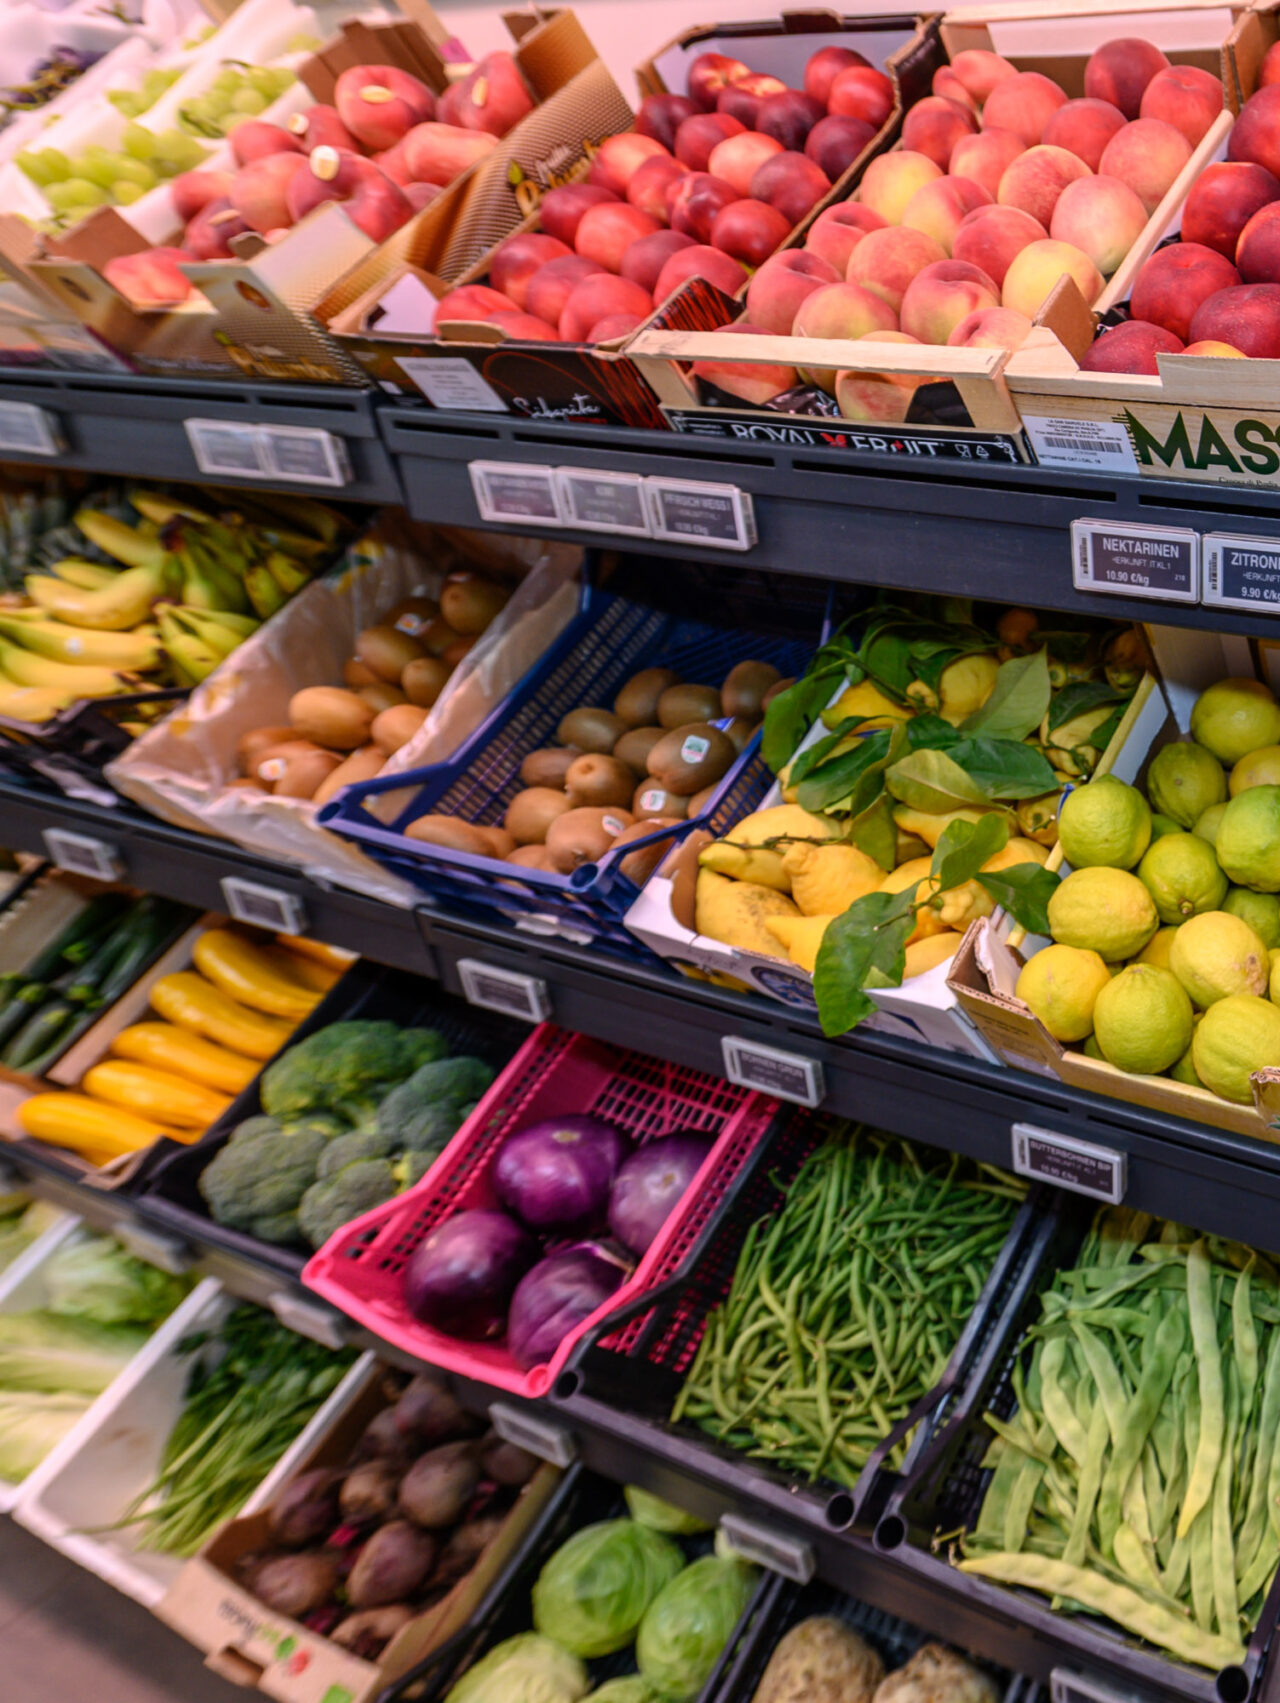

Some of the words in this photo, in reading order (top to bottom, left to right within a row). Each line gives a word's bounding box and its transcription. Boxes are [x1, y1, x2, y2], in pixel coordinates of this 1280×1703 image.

[1103, 537, 1180, 559] NEKTARINEN
[1106, 570, 1128, 582] 10.90
[1130, 572, 1150, 587] €/kg
[1241, 586, 1261, 598] 9.90
